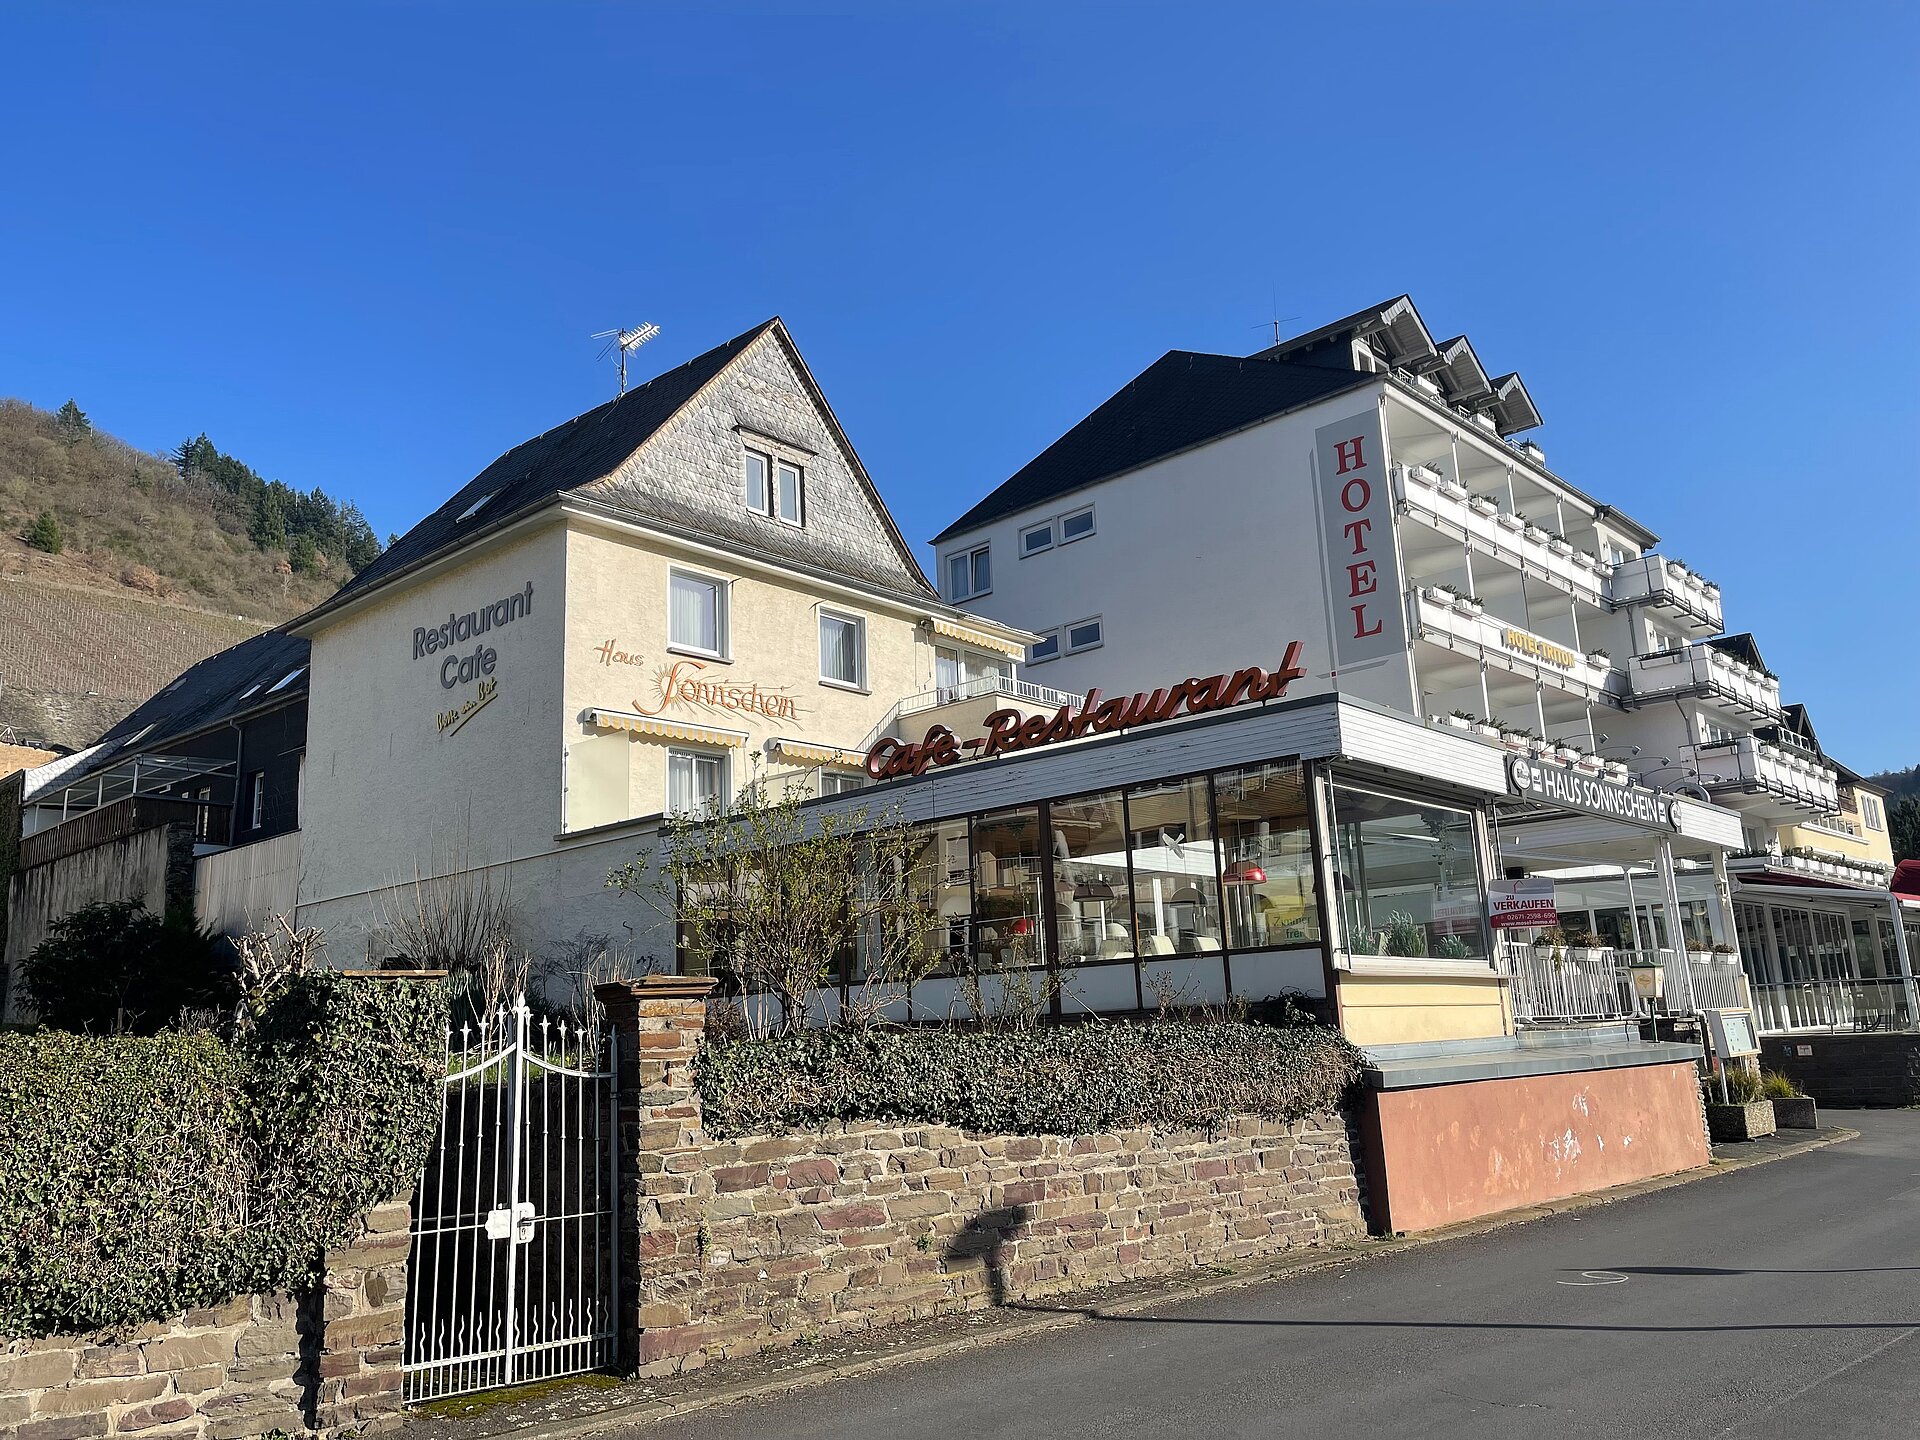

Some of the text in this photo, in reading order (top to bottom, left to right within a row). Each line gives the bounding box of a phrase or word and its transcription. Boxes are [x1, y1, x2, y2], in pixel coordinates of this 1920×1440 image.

[1333, 435, 1382, 639] HOTEL
[412, 580, 533, 661] Restaurant
[440, 644, 498, 690] Cafe
[593, 638, 645, 667] Haus
[1507, 629, 1575, 668] HOTEL TRITON
[477, 676, 499, 701] Bit
[631, 660, 797, 720] Sonnschein
[1543, 768, 1659, 823] HAUS SONNSCHEIN
[1493, 900, 1554, 910] VERKAUFEN
